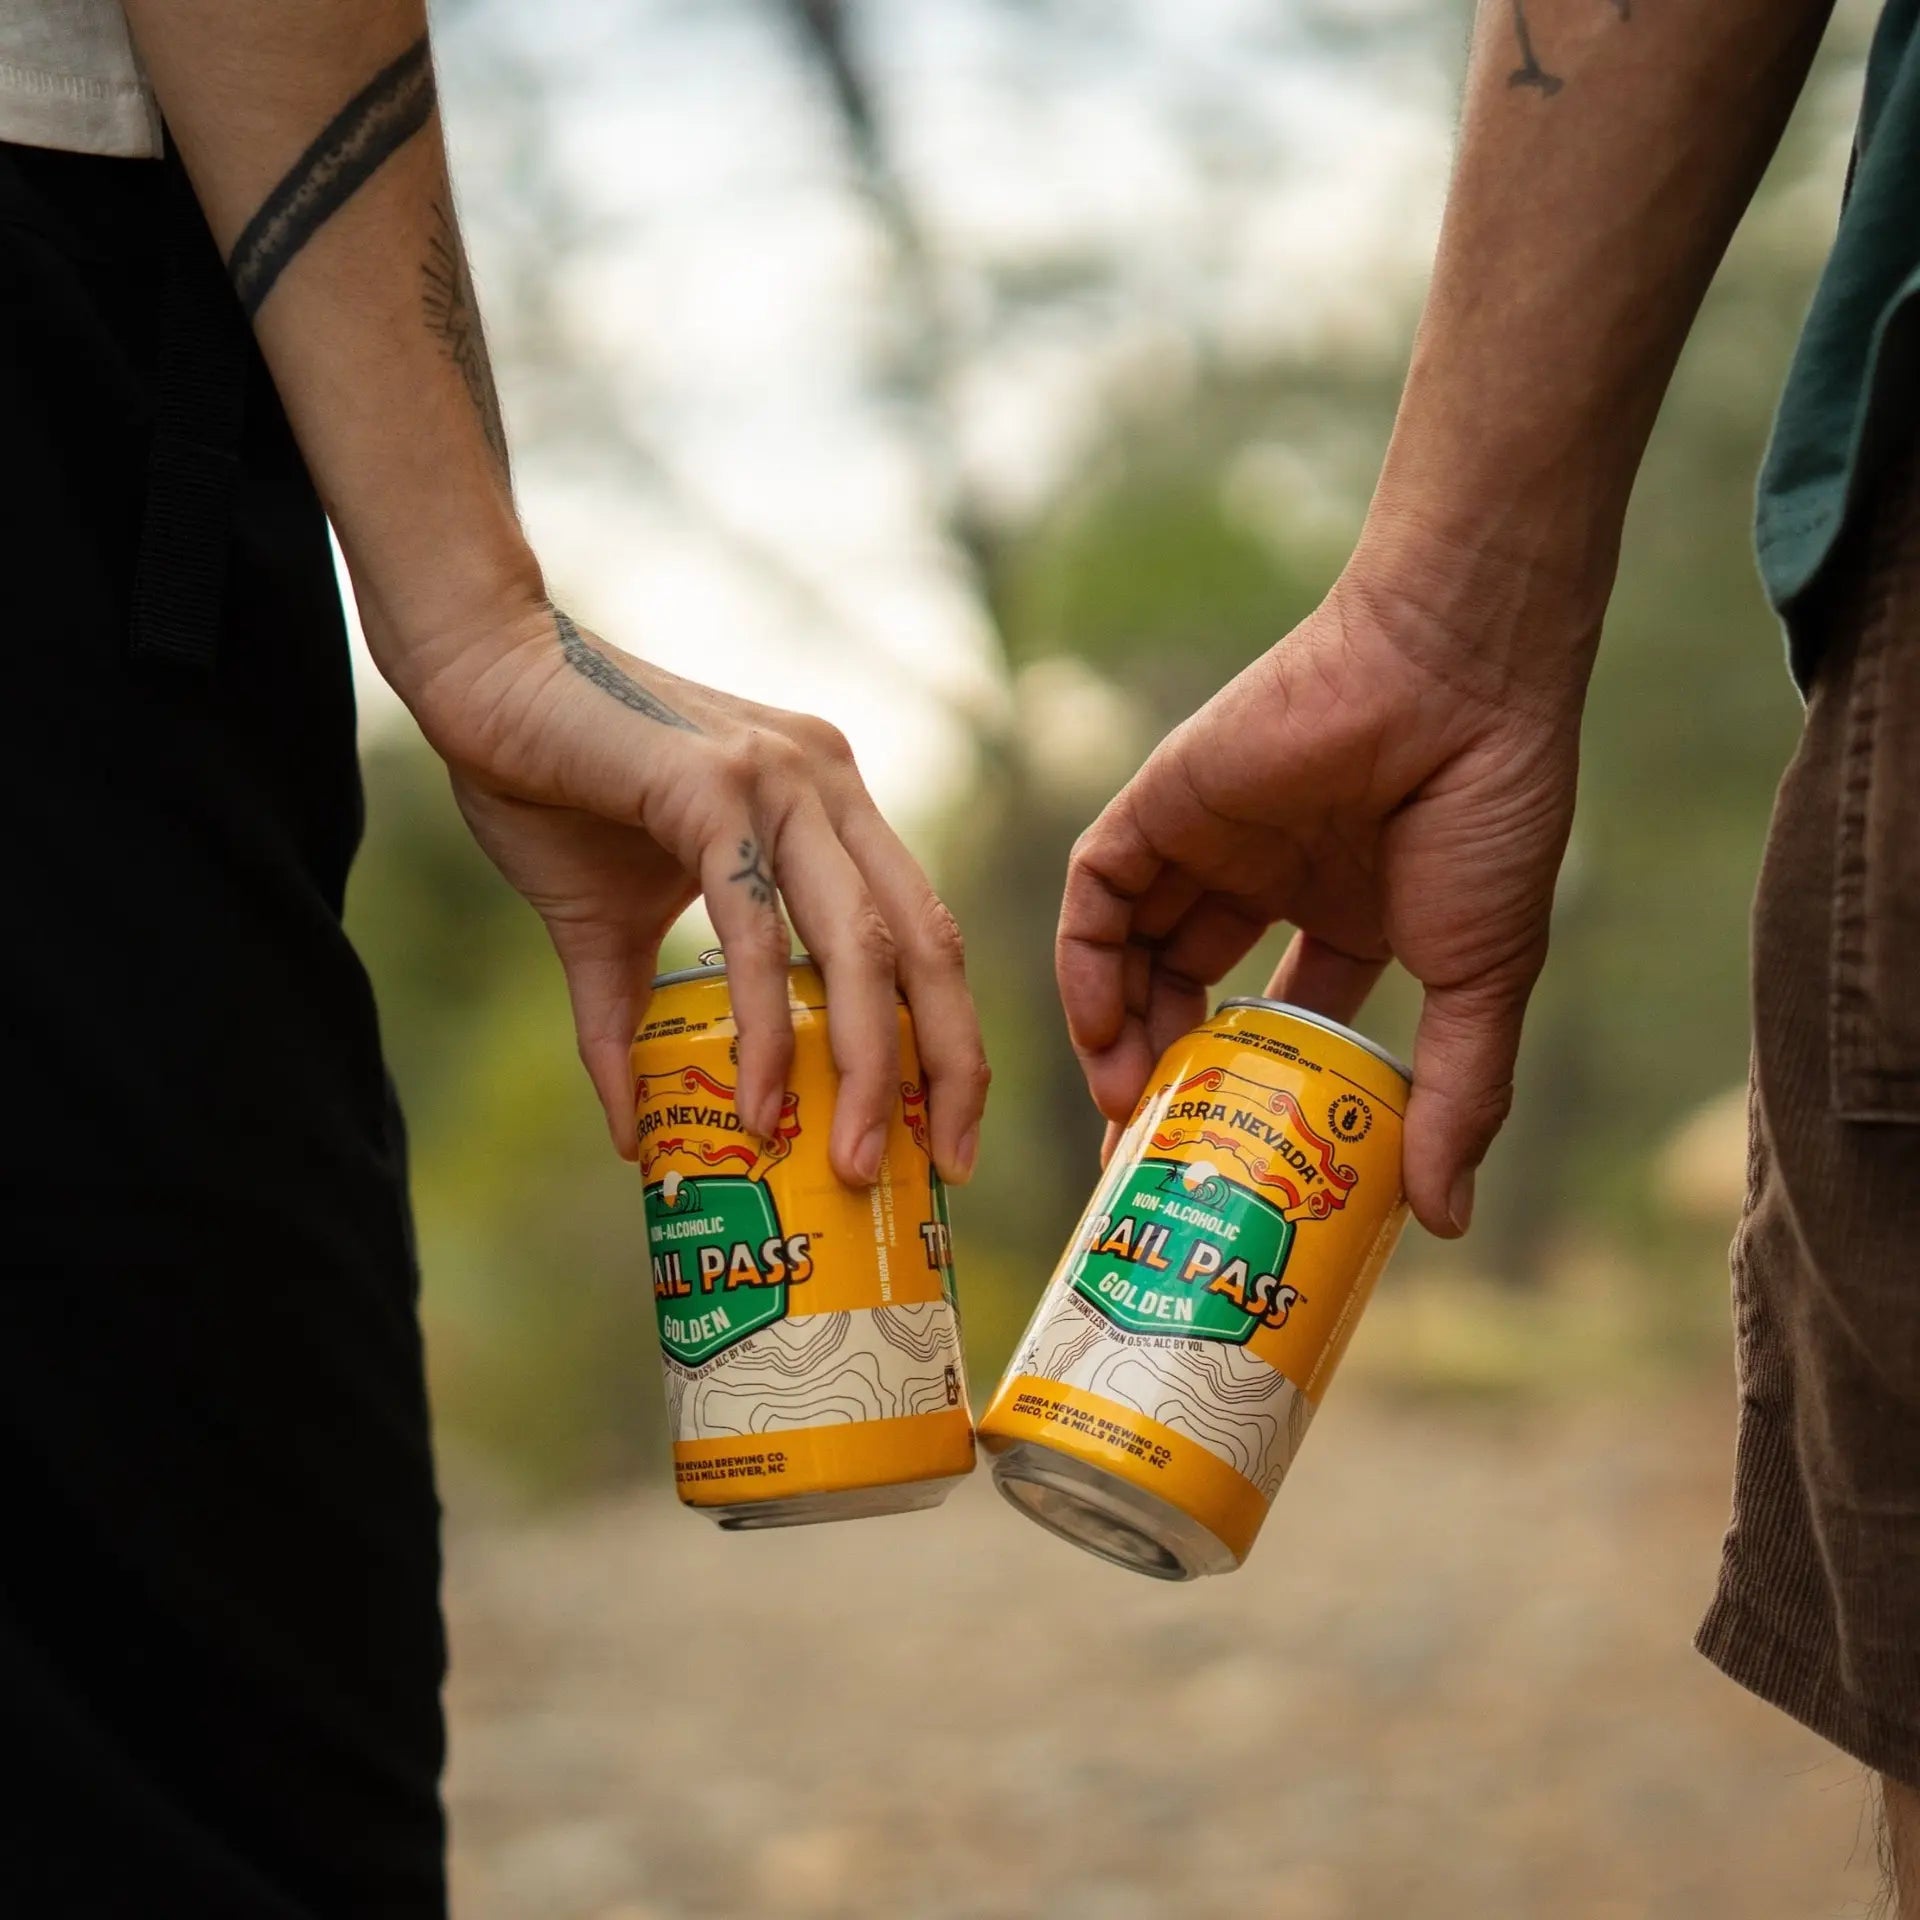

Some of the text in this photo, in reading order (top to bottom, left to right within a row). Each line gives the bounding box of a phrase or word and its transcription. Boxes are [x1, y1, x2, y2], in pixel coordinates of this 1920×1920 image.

[685, 1022, 708, 1033] OVER
[1239, 1030, 1267, 1042] FAMILY
[1213, 1032, 1253, 1046] OPERATED
[1260, 1043, 1297, 1062] ARGUED
[1298, 1057, 1323, 1073] OVER
[637, 1104, 744, 1143] RRA NEVAD
[1162, 1100, 1319, 1185] ERRA NEVADA
[1131, 1191, 1241, 1242] NON-ALCOHOLIC
[652, 1251, 693, 1300] AIL
[697, 1233, 814, 1296] PASS
[1083, 1214, 1173, 1272] RAIL
[1177, 1238, 1299, 1330] PASS
[1098, 1271, 1193, 1321] GOLDEN
[664, 1306, 731, 1344] GOLDEN
[1067, 1292, 1205, 1353] CONTAINS LESS THAN 0.5% ALC BY VOL
[715, 1354, 730, 1369] ALC
[728, 1346, 740, 1360] BY
[739, 1339, 757, 1354] VOL
[1012, 1403, 1168, 1470] CHICO, CA & MILLS RIVER, NC
[1017, 1393, 1173, 1462] SIERRA NEVADA BREWING CO.
[701, 1469, 726, 1481] MILLS
[728, 1465, 767, 1478] RIVER,
[767, 1463, 786, 1474] NC
[715, 1454, 765, 1468] BREWING
[767, 1452, 788, 1463] CO.
